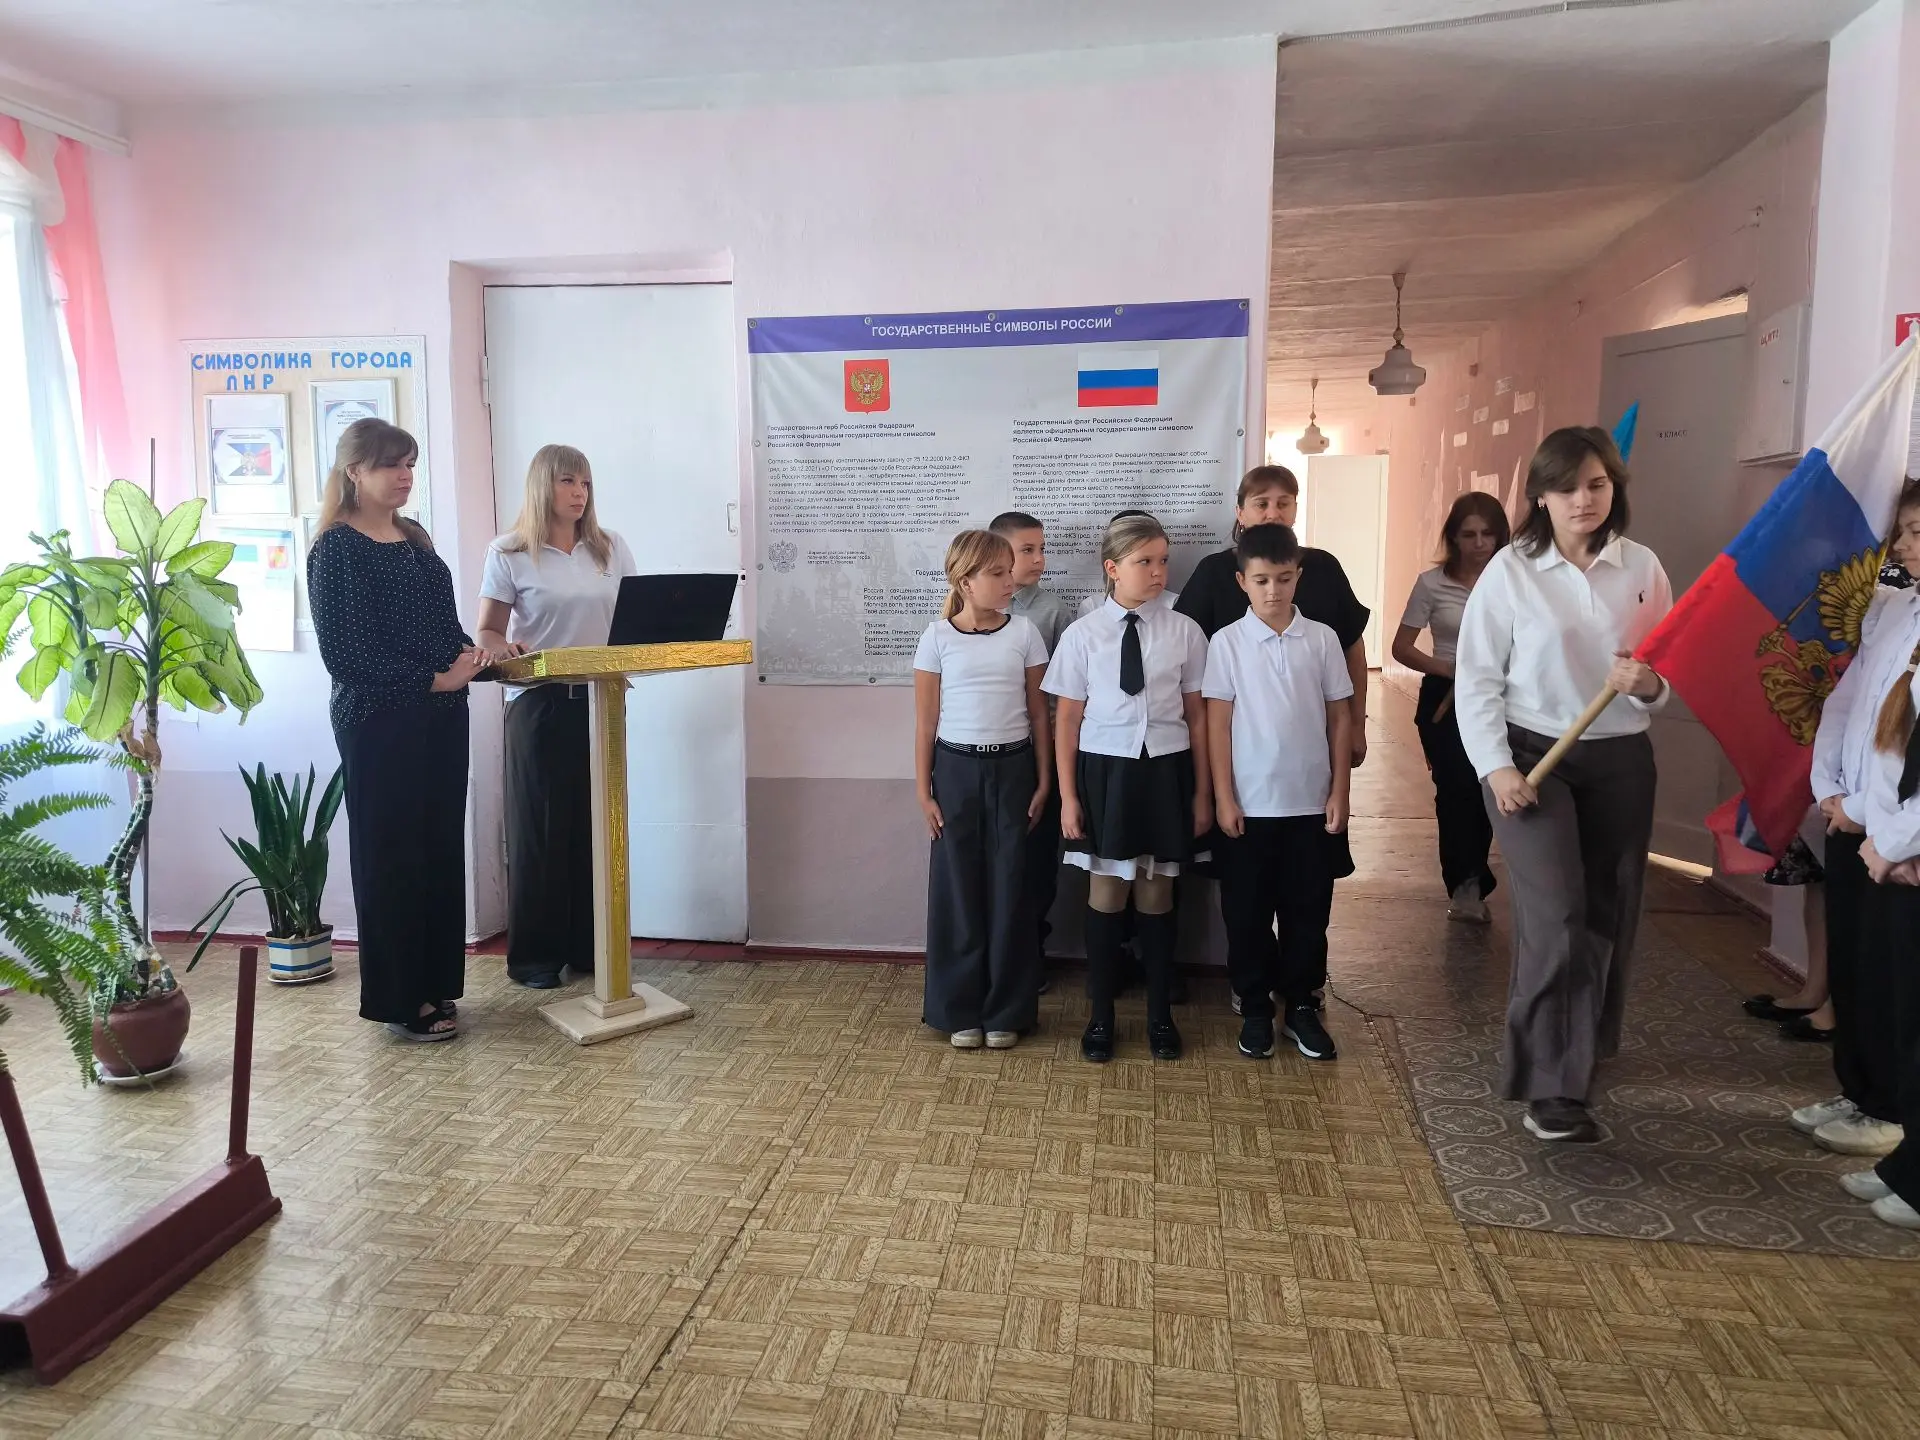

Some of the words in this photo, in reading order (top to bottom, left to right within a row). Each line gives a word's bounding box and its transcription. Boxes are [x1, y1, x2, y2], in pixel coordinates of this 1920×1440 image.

[872, 323, 991, 338] ГОСУДАРСТВЕННЫЕ
[994, 320, 1058, 333] СИМВОЛЫ
[1060, 318, 1112, 330] РОССИИ
[192, 352, 312, 370] СИМВОЛИКА
[332, 352, 412, 368] ГОРОДА
[226, 374, 274, 390] ЛНР
[1014, 417, 1072, 427] Государственный
[1073, 417, 1091, 425] флаг
[1092, 416, 1132, 424] Российской
[1133, 415, 1172, 424] Федерации
[1012, 426, 1042, 434] является
[1044, 425, 1094, 434] официальным
[1095, 424, 1156, 434] государственным
[1158, 423, 1194, 432] символом
[1013, 435, 1052, 443] Российской
[1053, 434, 1092, 443] Федерации
